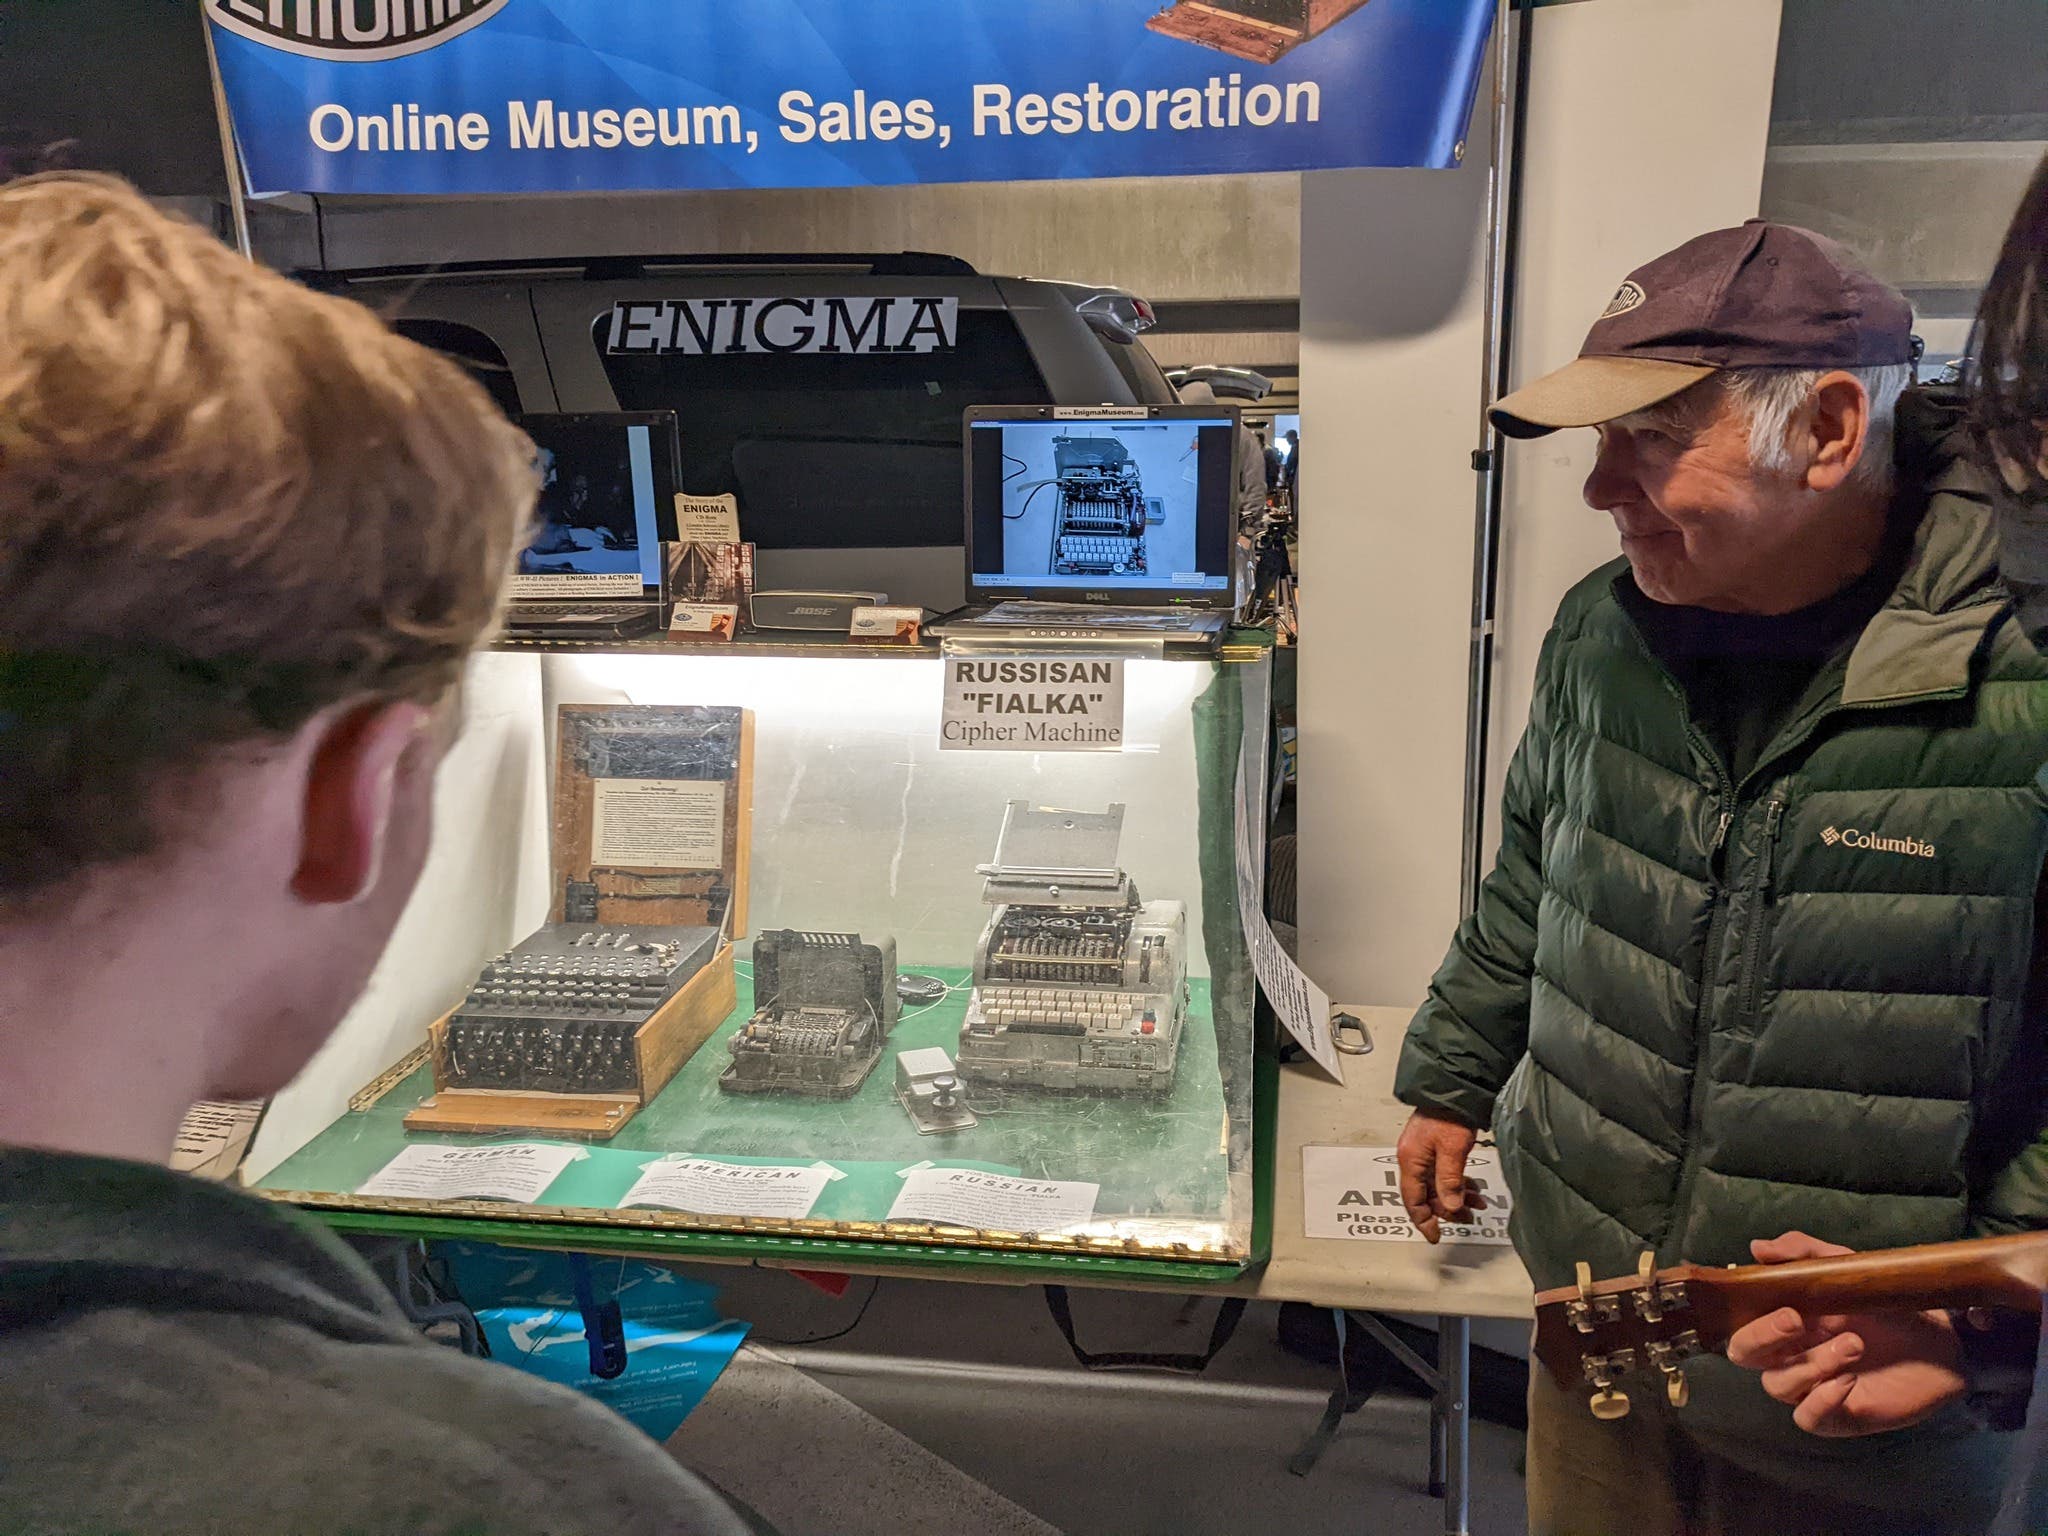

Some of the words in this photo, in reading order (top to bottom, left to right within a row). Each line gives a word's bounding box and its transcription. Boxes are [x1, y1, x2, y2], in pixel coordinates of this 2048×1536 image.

[309, 103, 490, 152] Online
[508, 99, 758, 154] Museum,
[778, 89, 951, 149] Sales,
[972, 73, 1321, 136] Restoration
[608, 297, 954, 354] ENIGMA
[683, 504, 728, 513] ENIGMA
[1086, 592, 1110, 601] DELL
[787, 606, 838, 616] BOSE
[956, 662, 1112, 684] RUSSISAN
[962, 692, 1103, 715] "FIALKA"
[943, 719, 1018, 746] Cipher
[1025, 720, 1121, 743] Machine
[1841, 828, 1936, 858] Columbia
[443, 1149, 536, 1160] GERMAN
[676, 1163, 801, 1180] AMERICAN
[950, 1174, 1058, 1194] RUSSIAN
[1337, 1212, 1412, 1224] Pleas
[1348, 1224, 1414, 1238] (802)
